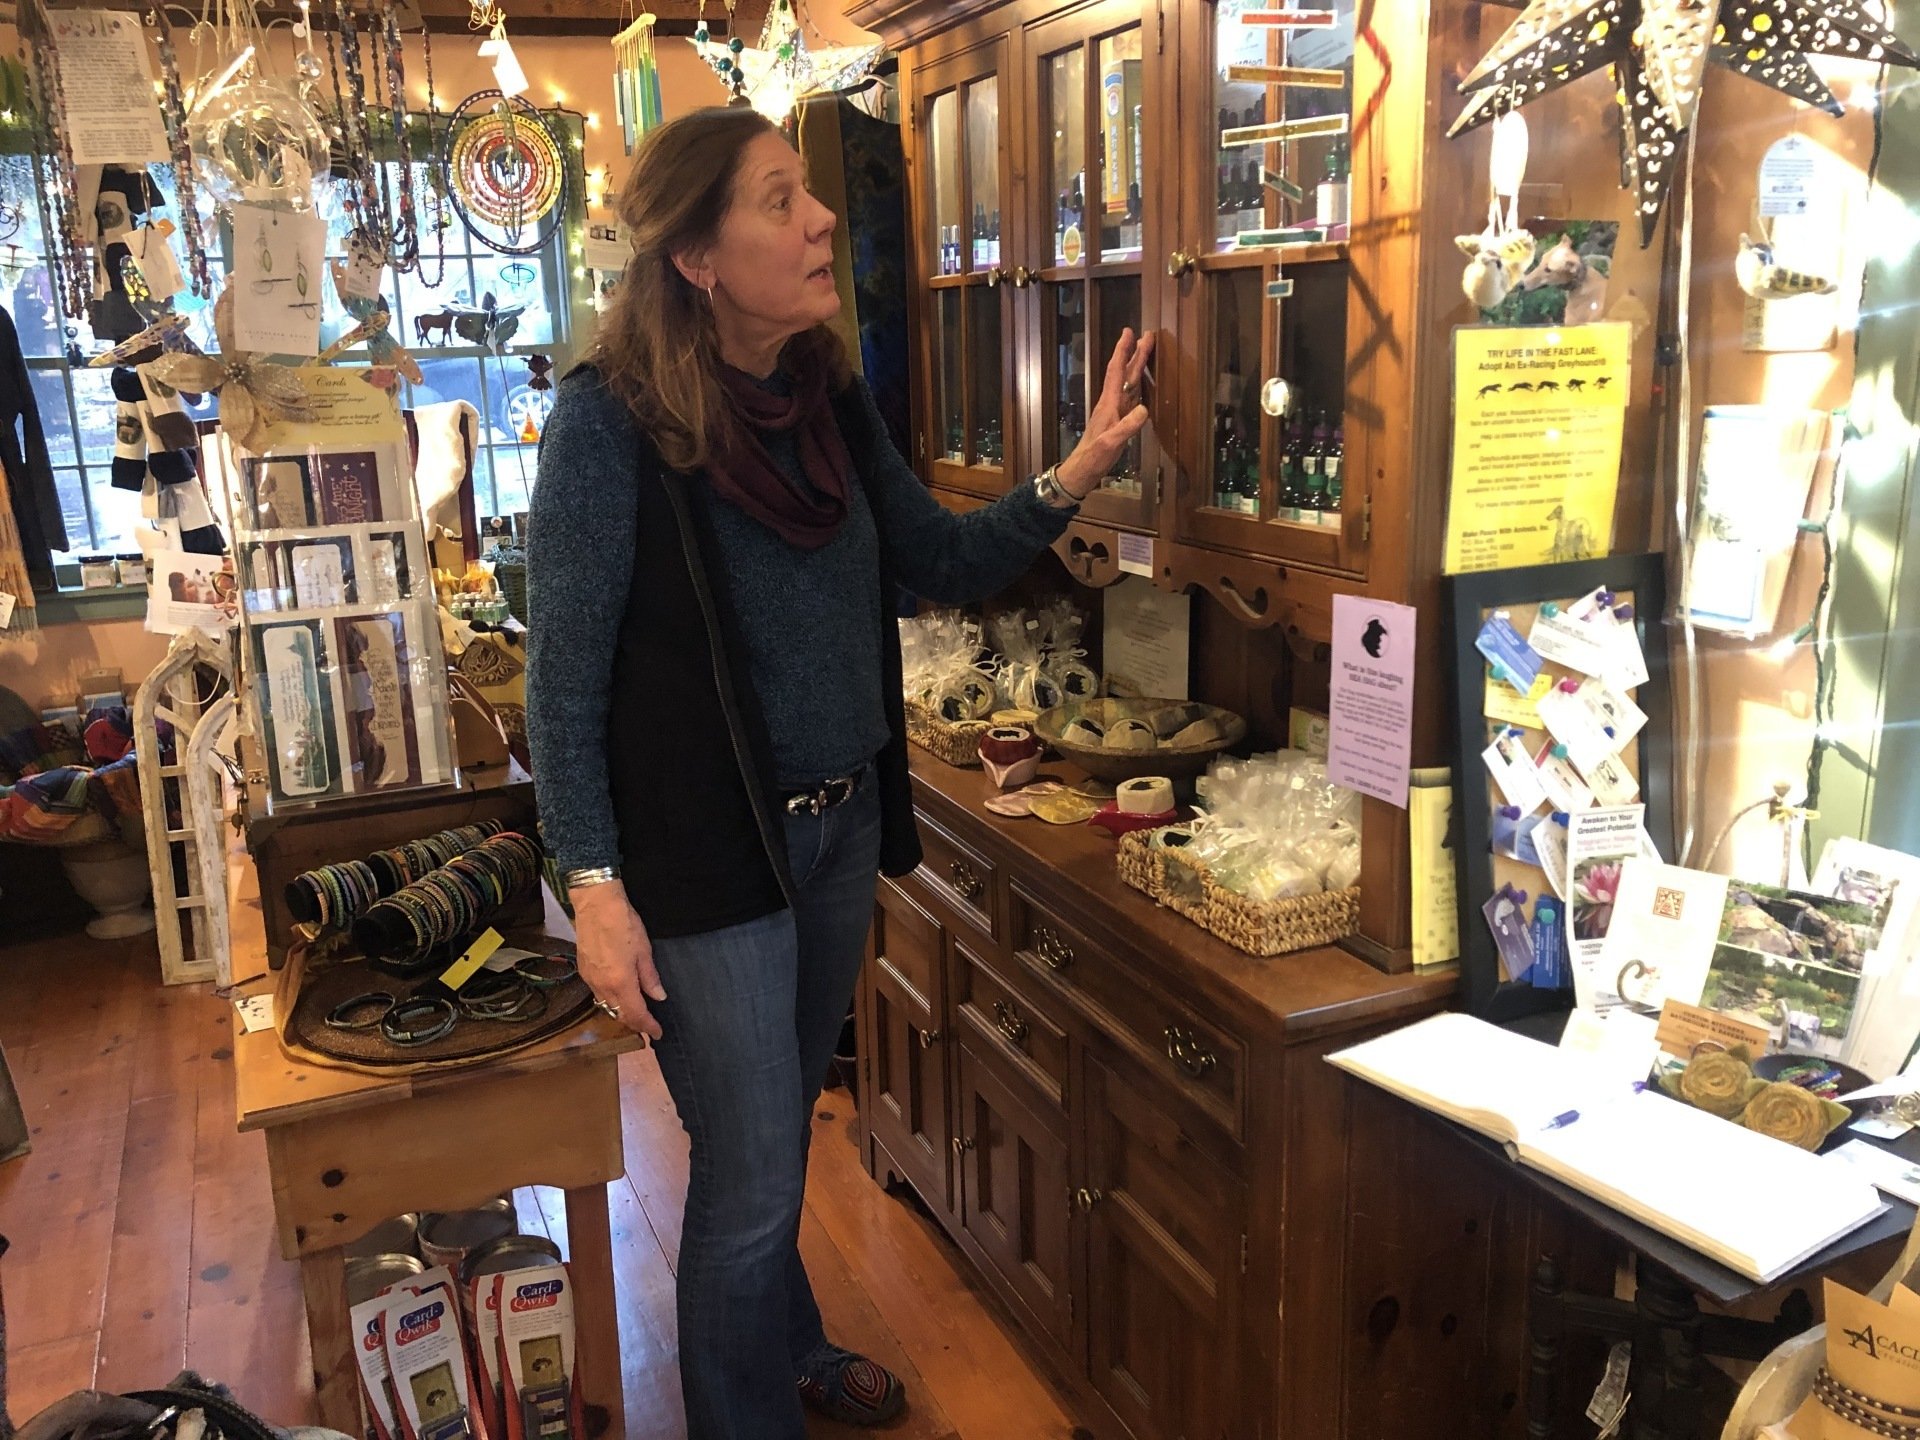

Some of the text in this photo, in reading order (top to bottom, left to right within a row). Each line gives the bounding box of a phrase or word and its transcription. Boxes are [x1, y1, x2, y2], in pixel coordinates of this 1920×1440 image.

[1488, 349, 1504, 358] TRY
[1506, 348, 1523, 357] LIFE
[1526, 348, 1533, 356] IN
[1536, 347, 1551, 356] THE
[1554, 346, 1574, 355] FAST
[1478, 362, 1502, 371] Adopt
[1505, 361, 1515, 369] An
[1518, 359, 1556, 369] Ex-Racing
[1342, 661, 1358, 672] What
[1379, 670, 1404, 685] laughing
[1577, 823, 1636, 834] Greatest Potential
[513, 1296, 550, 1309] Qwik
[398, 1322, 434, 1342] Qwik
[1843, 1324, 1920, 1361] ACACI
